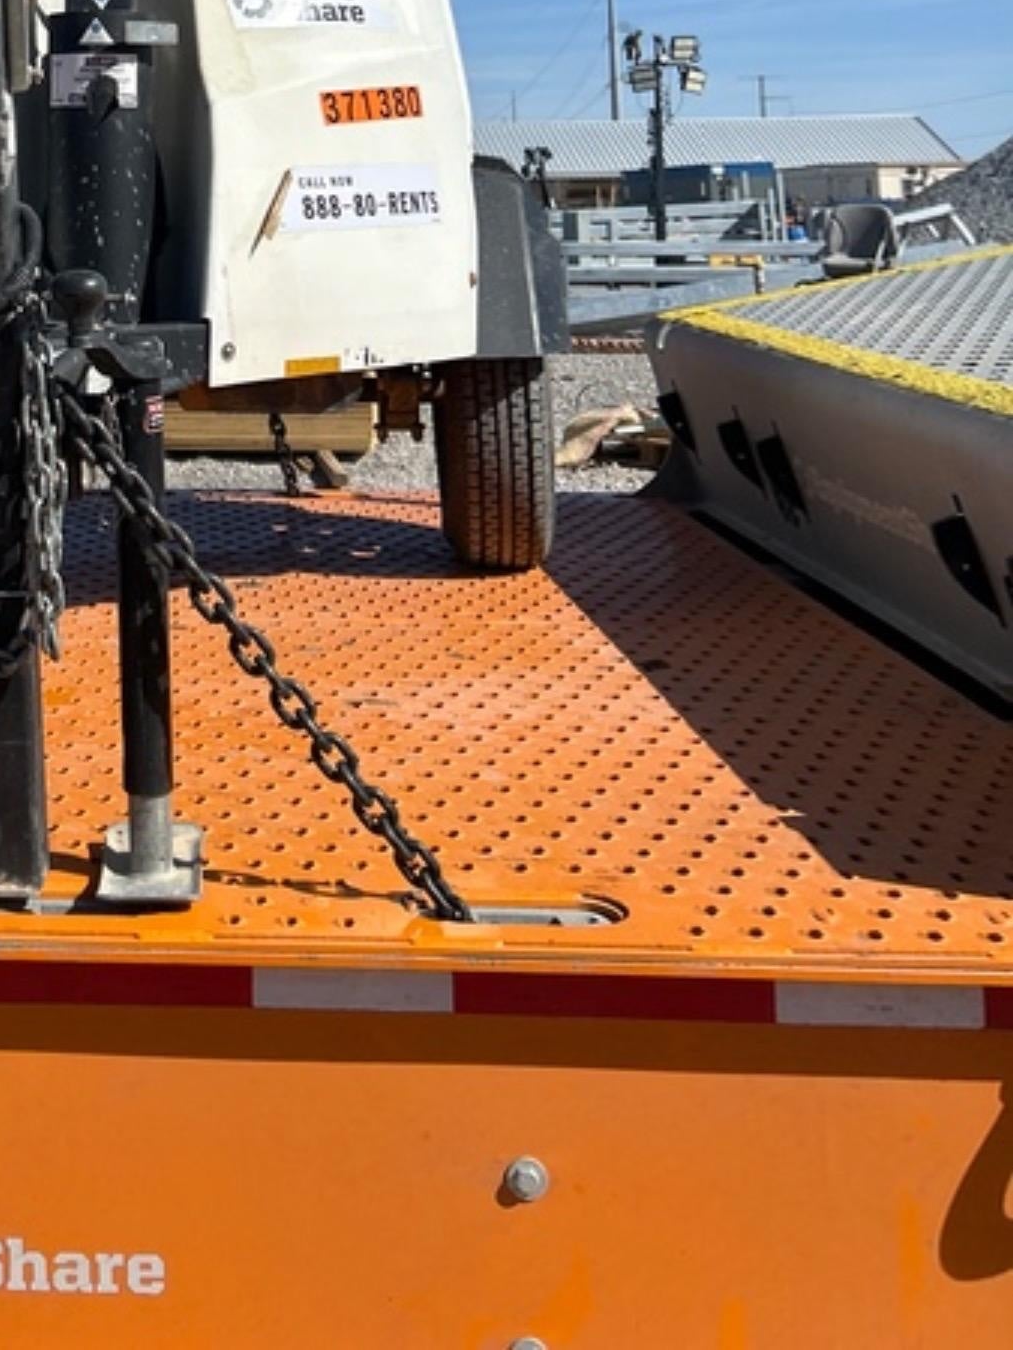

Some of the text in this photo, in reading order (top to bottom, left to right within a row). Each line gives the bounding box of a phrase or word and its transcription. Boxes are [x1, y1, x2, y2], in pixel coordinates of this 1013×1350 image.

[321, 86, 422, 124] 371380
[298, 176, 354, 189] CALL NOW
[301, 191, 440, 219] 888-80-RENTS
